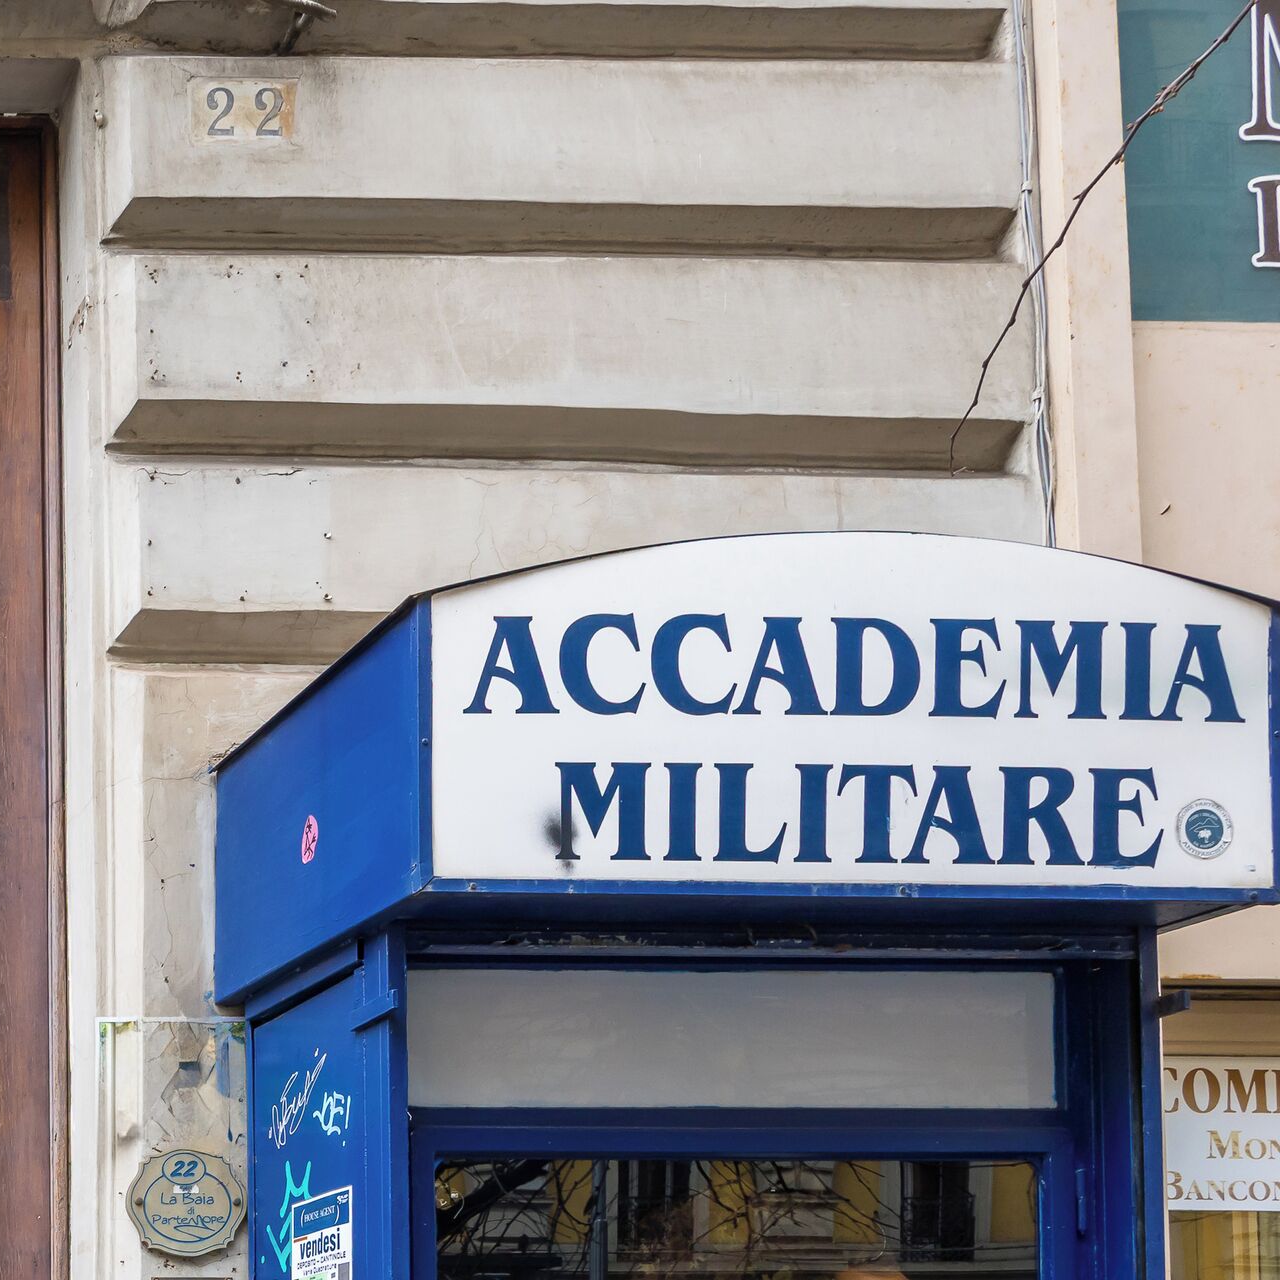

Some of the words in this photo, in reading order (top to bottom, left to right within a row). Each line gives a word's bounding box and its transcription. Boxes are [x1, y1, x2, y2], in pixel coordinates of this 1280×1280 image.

[206, 86, 285, 138] 22
[463, 613, 1246, 723] ACCADEMIA
[555, 760, 1164, 868] MILITARE
[1164, 1067, 1280, 1114] COM
[170, 1160, 199, 1178] 22
[160, 1193, 177, 1206] La
[182, 1192, 215, 1206] Baia
[187, 1206, 195, 1216] di
[300, 1227, 341, 1260] vendesi
